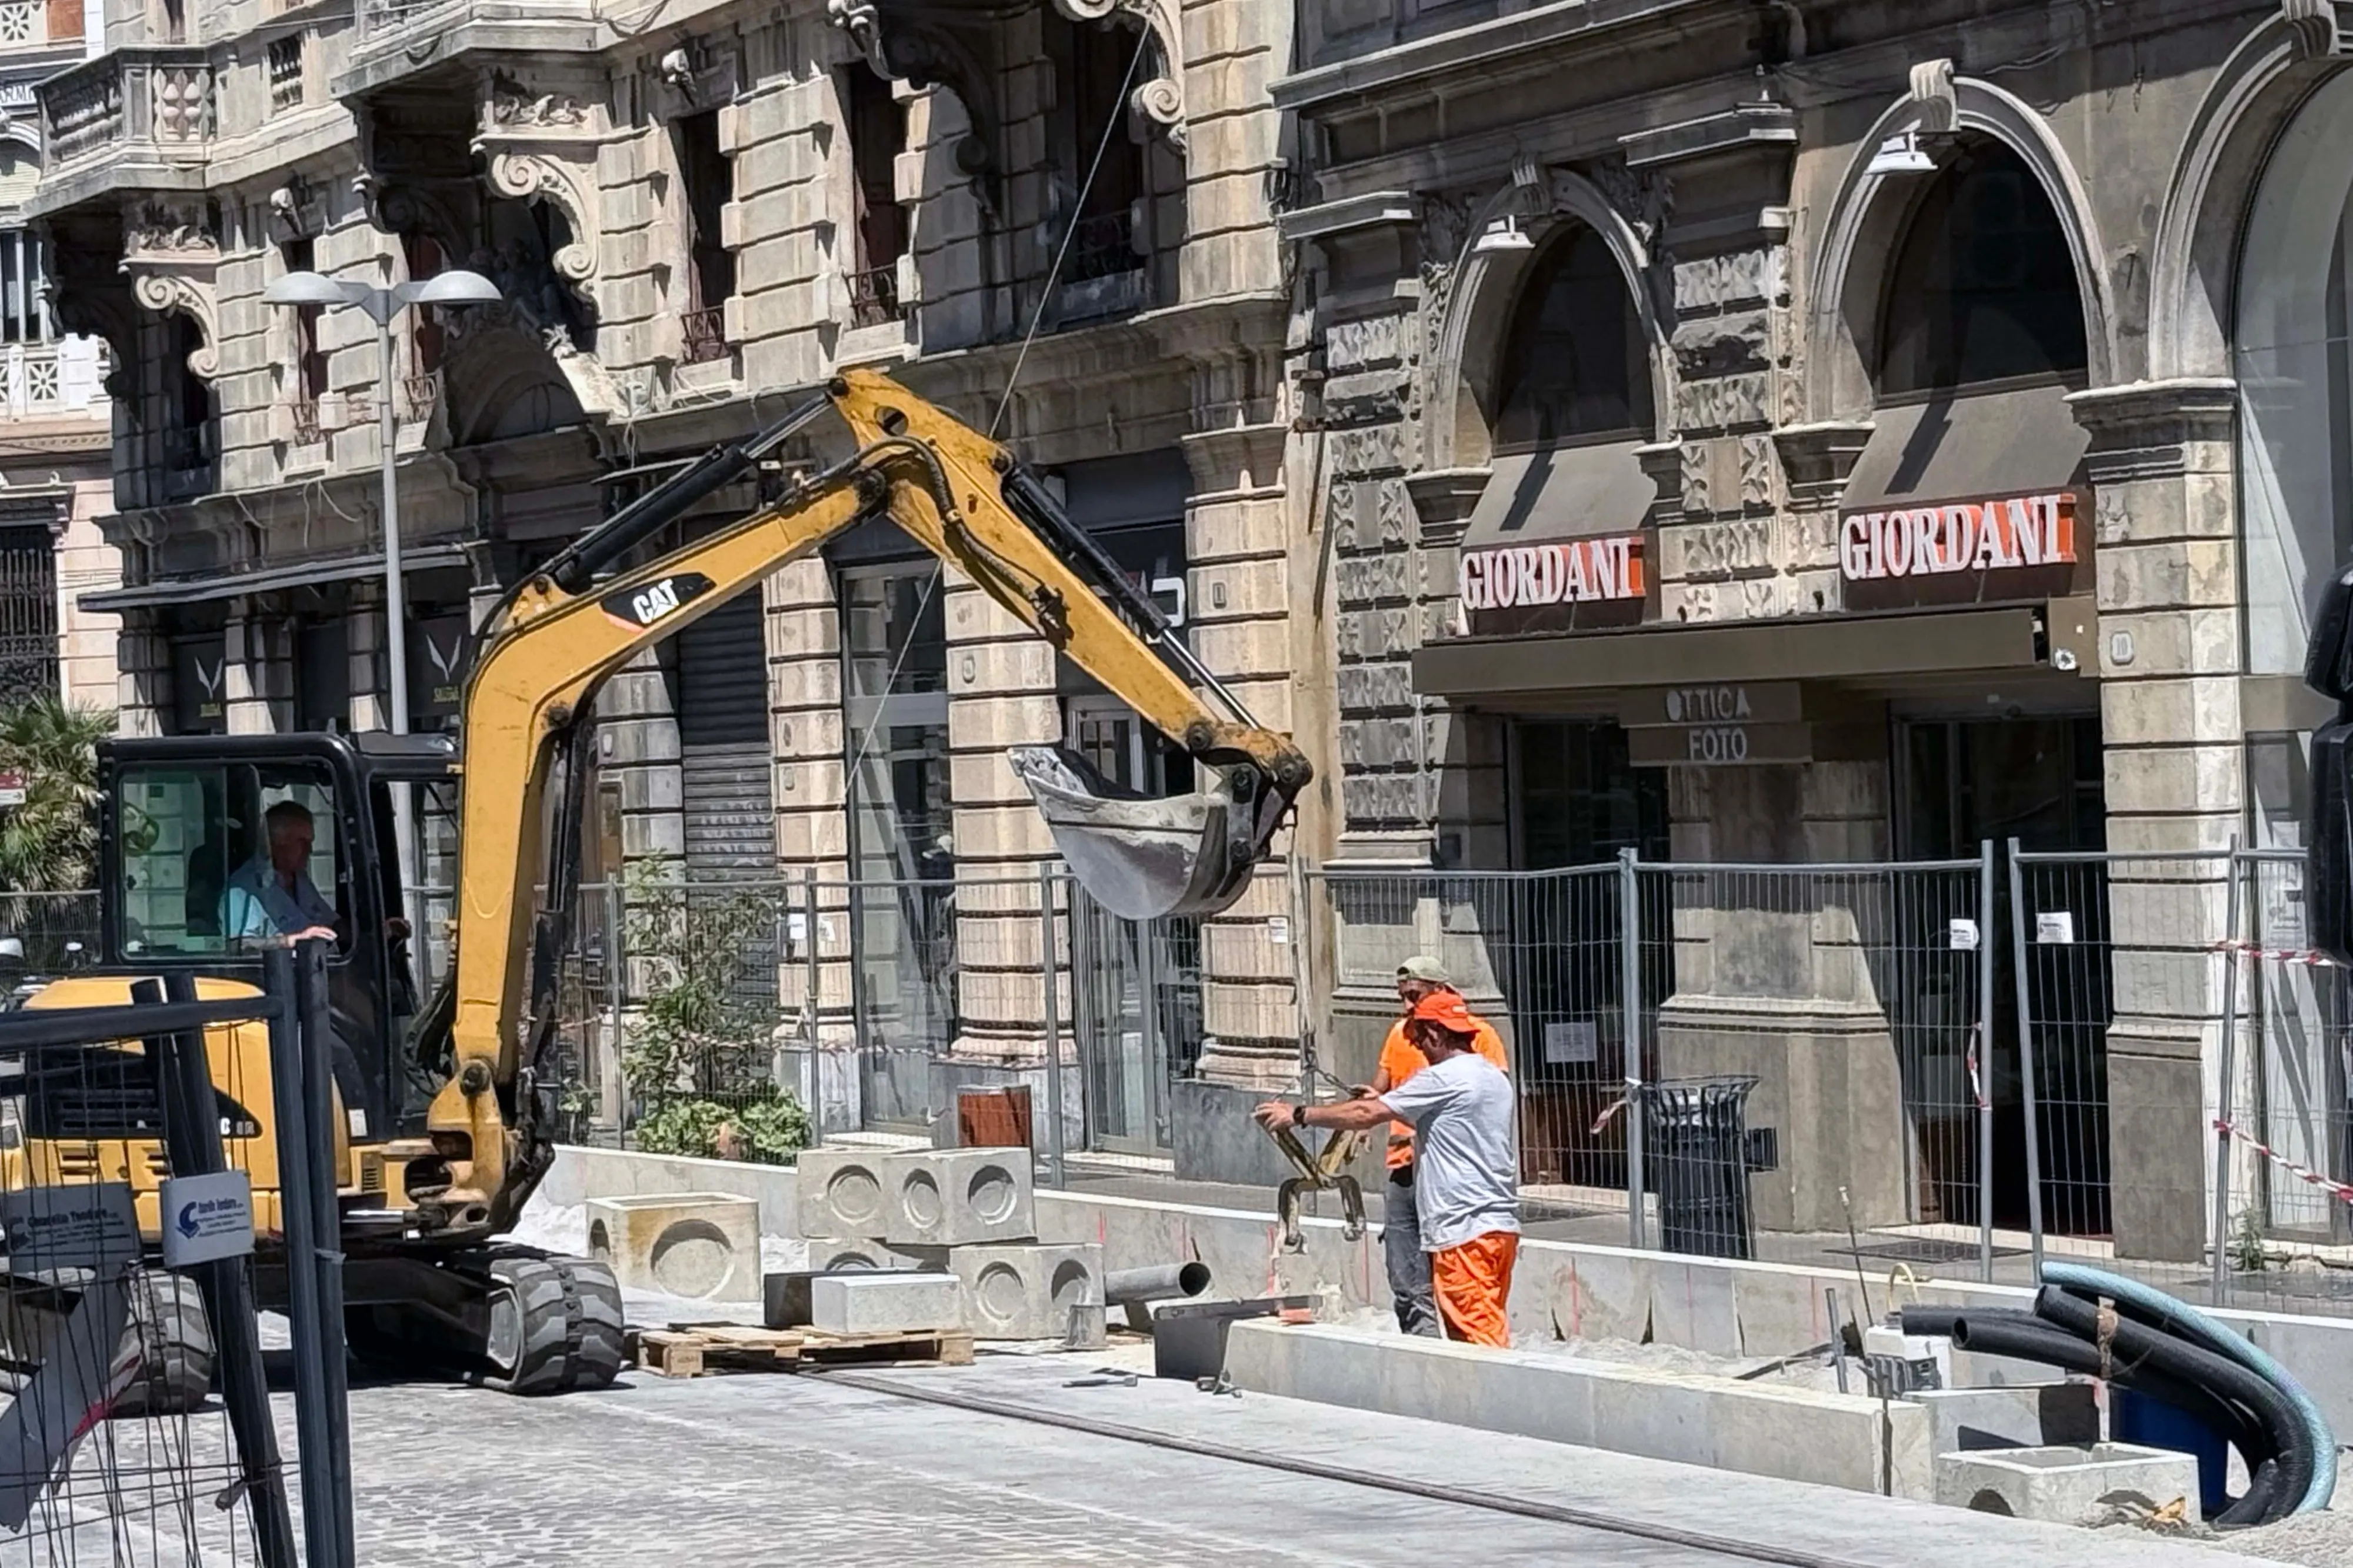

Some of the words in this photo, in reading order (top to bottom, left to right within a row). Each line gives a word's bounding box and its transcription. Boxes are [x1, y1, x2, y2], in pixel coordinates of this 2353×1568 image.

[1840, 493, 2065, 581] GIORDANI
[1460, 537, 1633, 610] GIORDANI
[633, 579, 680, 624] CAT
[1666, 687, 1751, 722] OTTICA
[1688, 728, 1748, 761] FOTO
